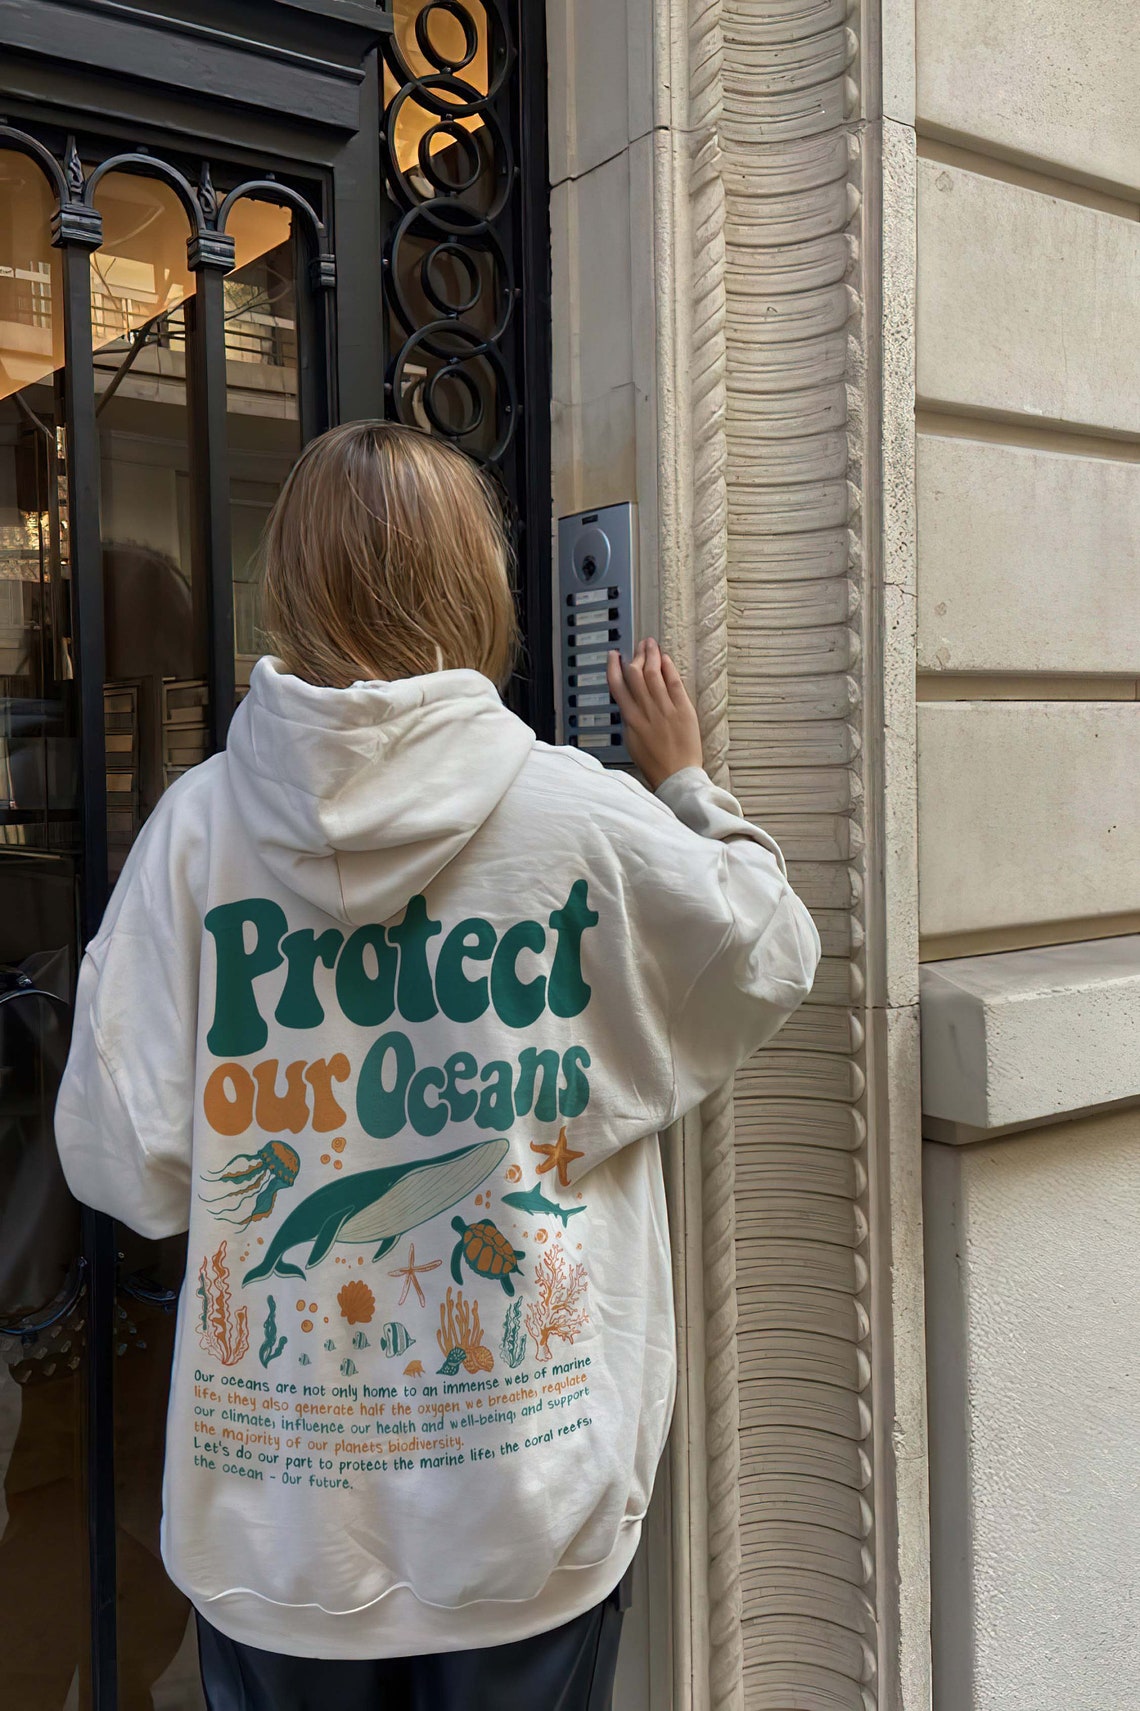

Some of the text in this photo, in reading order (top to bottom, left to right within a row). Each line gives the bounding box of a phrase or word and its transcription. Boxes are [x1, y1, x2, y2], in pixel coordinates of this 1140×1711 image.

[204, 879, 599, 1057] Protect
[203, 1031, 591, 1139] our Oceans
[194, 1356, 591, 1401] Our oceans are not only home to an immense web of marine
[194, 1373, 587, 1417] life, they also generate half the oxygen we breathe, regulate
[194, 1386, 590, 1434] our climate, influence our health and well-being, and support
[194, 1422, 464, 1455] the majority of our planets biodiversity.
[194, 1418, 592, 1474] Let's do our part to protect the marine life, the coral reefs,
[194, 1455, 216, 1469] the
[222, 1463, 263, 1480] ocean
[282, 1472, 302, 1484] Our
[309, 1475, 353, 1489] future.
